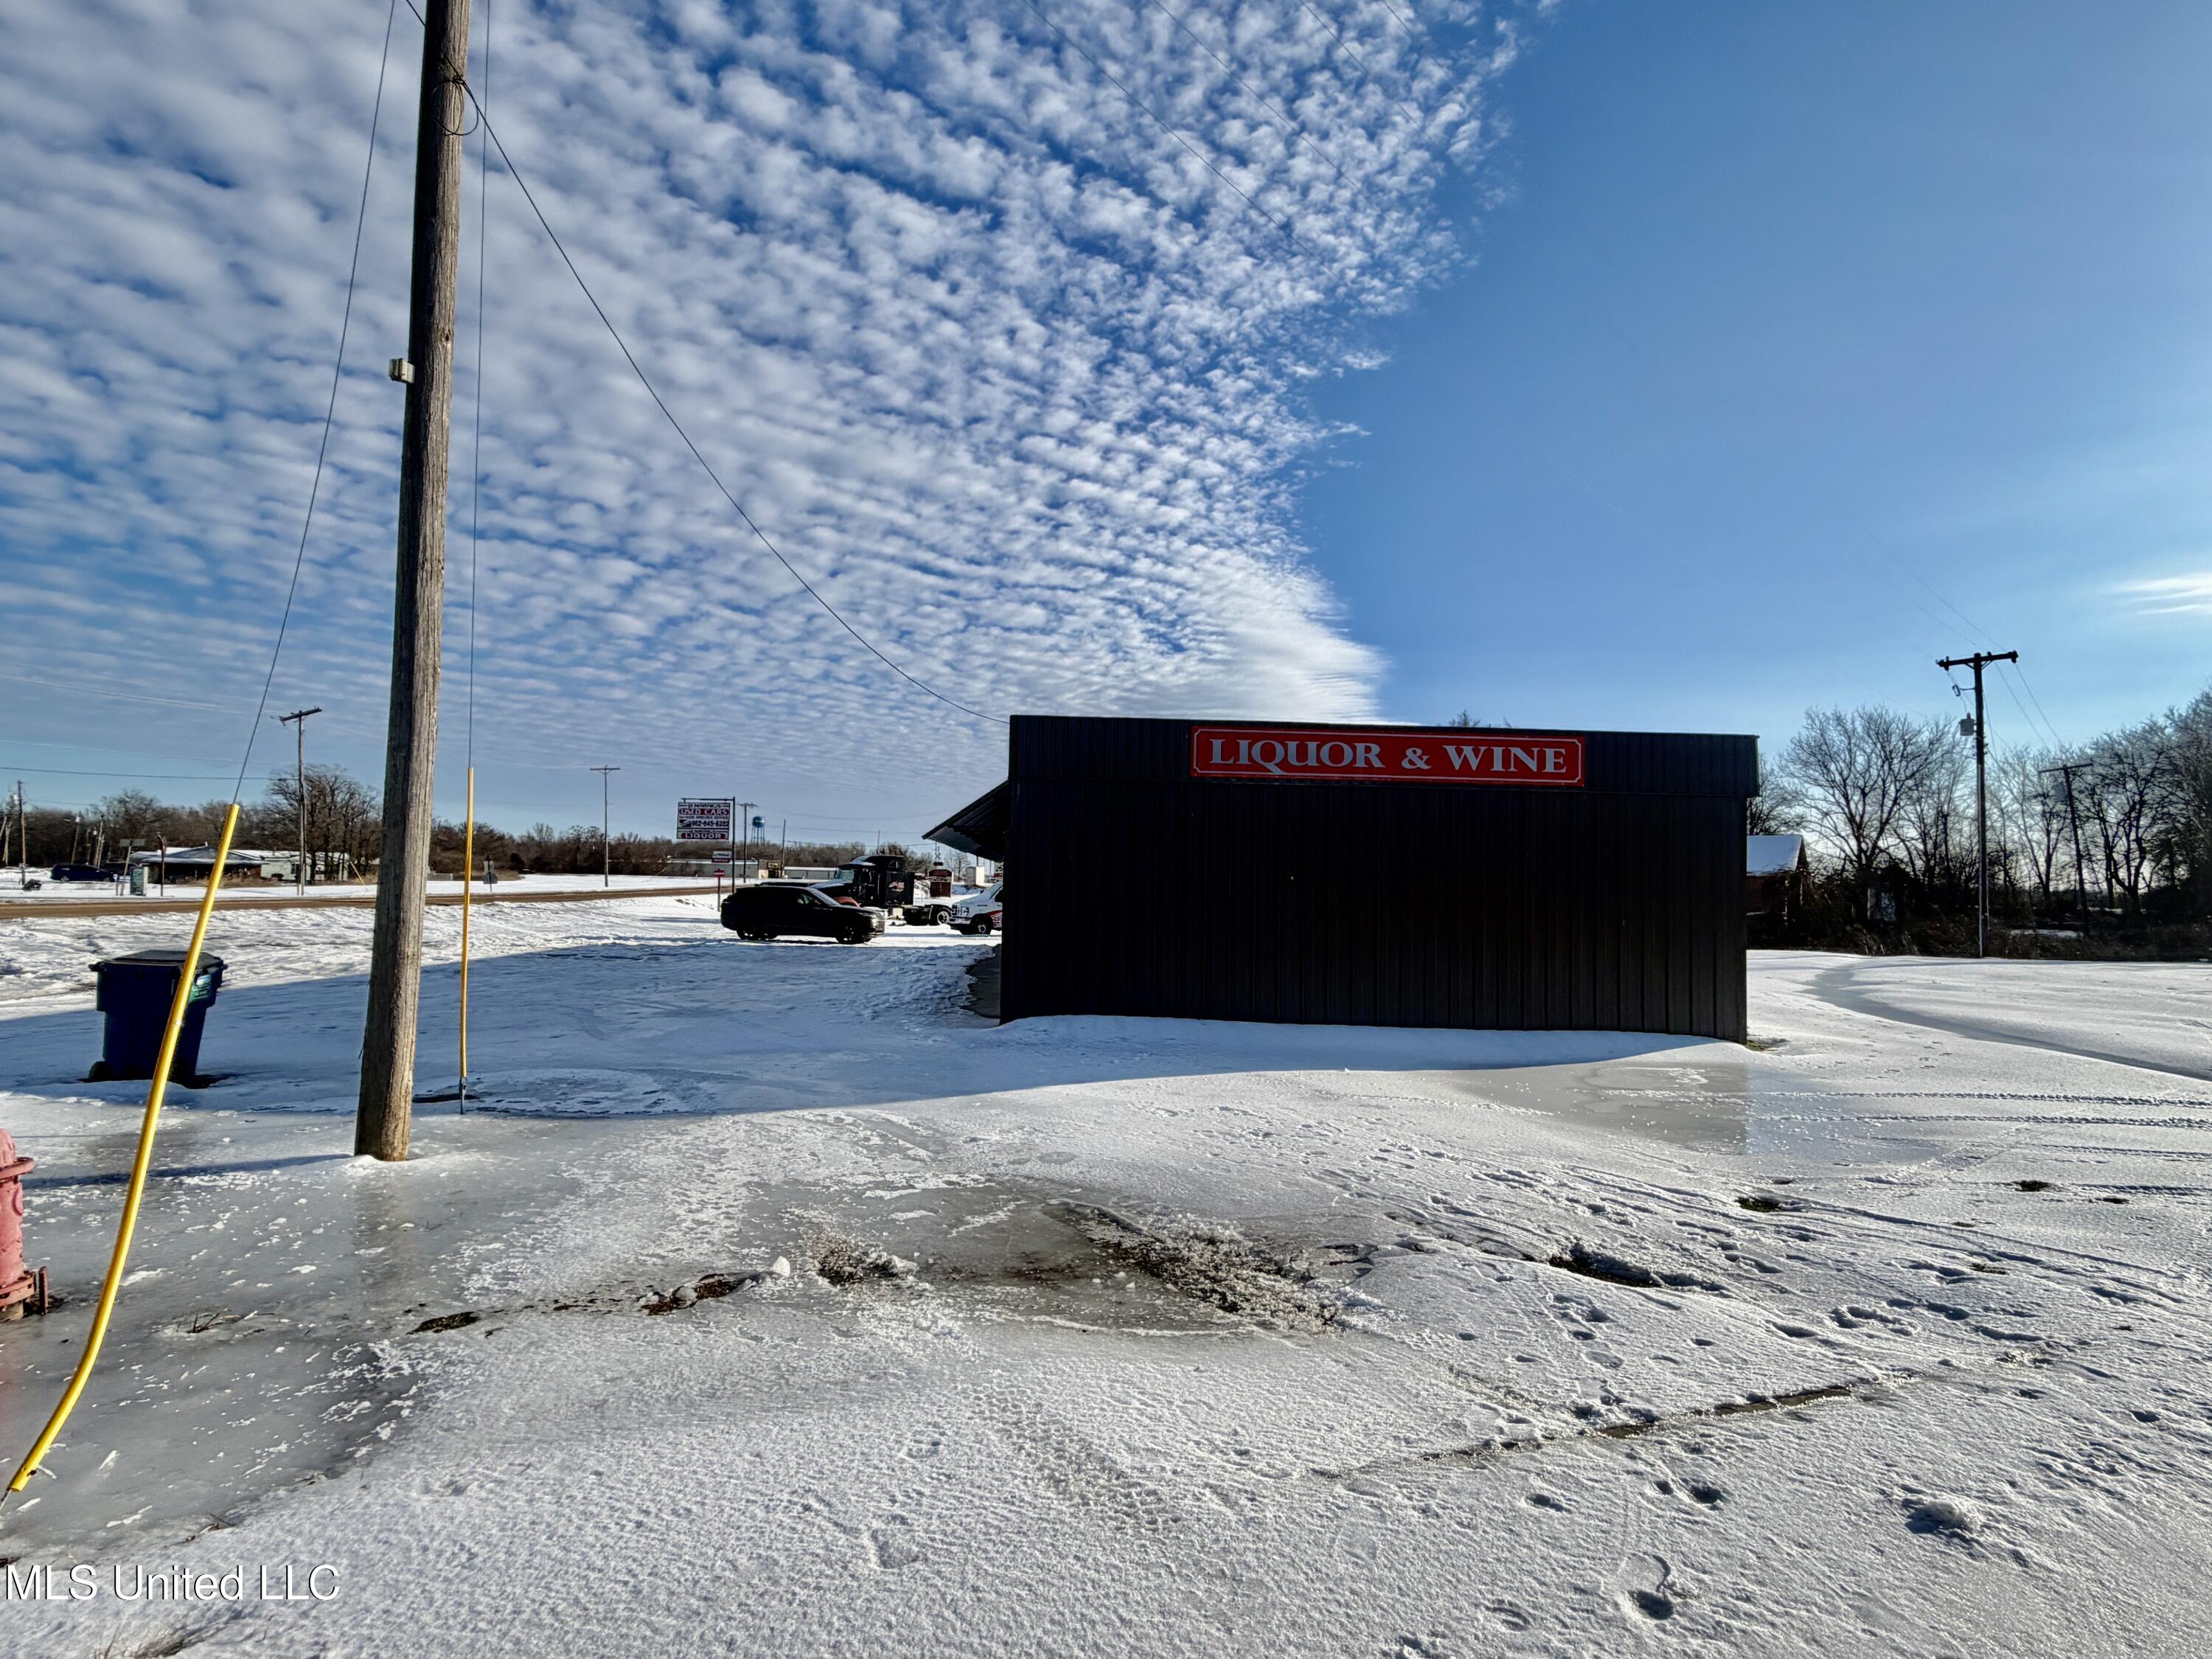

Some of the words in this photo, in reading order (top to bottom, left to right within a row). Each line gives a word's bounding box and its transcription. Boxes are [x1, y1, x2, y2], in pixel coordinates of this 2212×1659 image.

[1208, 738, 1385, 775] LIQUOR
[1401, 747, 1432, 770] &
[1442, 745, 1568, 773] WINE
